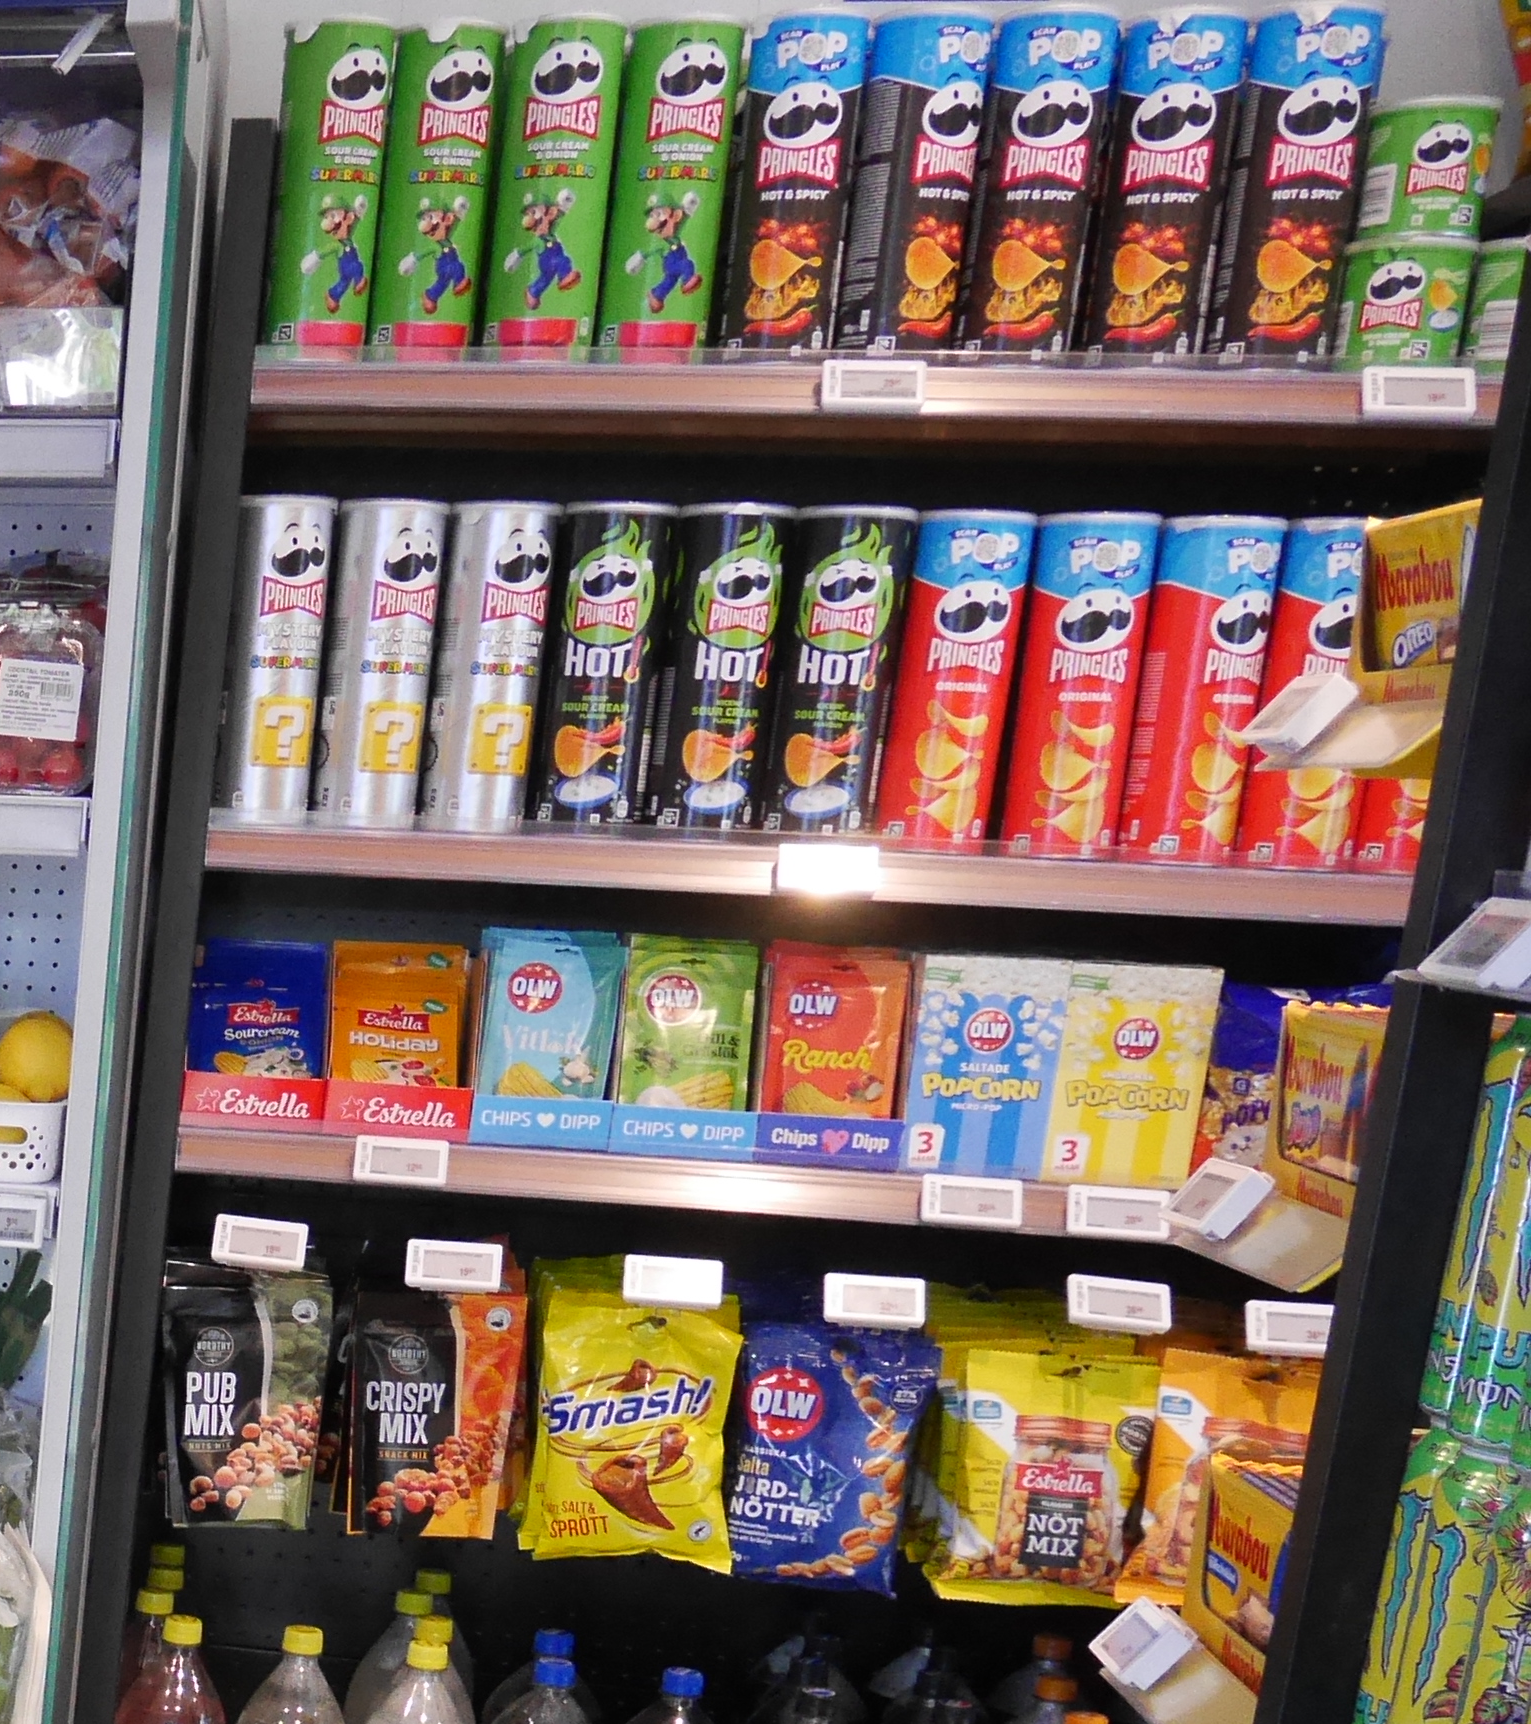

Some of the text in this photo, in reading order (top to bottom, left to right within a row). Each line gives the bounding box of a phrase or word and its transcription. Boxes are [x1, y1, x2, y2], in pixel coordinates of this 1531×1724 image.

[323, 105, 384, 138] PRINGLES
[421, 111, 490, 142] PRINGLES
[526, 102, 596, 135] PRINGLES
[651, 105, 722, 138] PRINGLES
[652, 144, 714, 155] SOUR CREAM
[759, 146, 837, 183] PRINGLES
[1006, 145, 1089, 183] PRINGLES
[1272, 143, 1354, 181] PRINGLES
[1125, 148, 1209, 186] PRINGLES
[1409, 166, 1468, 194] PRINGLES
[761, 191, 783, 201] HOT
[796, 190, 829, 200] SPICY
[1362, 303, 1422, 329] PRINGLES
[1375, 553, 1456, 612] Marabou
[264, 585, 323, 615] PRINGLES
[376, 591, 435, 620] PRINGLES
[486, 591, 546, 621] PRINGLES
[577, 599, 637, 629] PRINGLES
[810, 605, 874, 635] PRINGLES
[927, 638, 1003, 674] PRINGLES
[1393, 621, 1437, 668] OREO
[566, 647, 627, 678] HOT
[797, 648, 865, 685] HOT
[1050, 648, 1128, 682] PRINGLES
[936, 682, 988, 693] ORIGINAL
[1059, 692, 1113, 703] ORIGINAL
[513, 977, 560, 999] OLW
[234, 1008, 292, 1025] Estrella
[790, 993, 838, 1016] OLW
[224, 1027, 299, 1041] Sourcream
[363, 1013, 425, 1031] Estrella
[970, 1019, 1008, 1041] OLW
[1117, 1028, 1157, 1050] OLW
[782, 1040, 873, 1071] Ranch
[960, 1062, 1010, 1075] SALTADE
[218, 1090, 311, 1118] Estrella
[363, 1097, 455, 1130] Estrella
[481, 1110, 600, 1130] CHIPS DIPP
[623, 1120, 745, 1142] CHIPS DIPP
[771, 1128, 890, 1153] Chips Dipp
[917, 1131, 935, 1154] 3
[1060, 1139, 1078, 1163] 3
[185, 1371, 236, 1403] PUB
[366, 1381, 447, 1413] CRISPY
[546, 1377, 712, 1434] Smash!
[750, 1386, 817, 1421] OLW
[183, 1404, 235, 1437] MIX
[379, 1413, 429, 1445] MIX
[1020, 1467, 1097, 1495] Estrella
[729, 1495, 820, 1527] NÖTTER
[1027, 1511, 1085, 1536] NÖT
[549, 1514, 609, 1539] SPRÖTT
[1027, 1535, 1078, 1559] MIX
